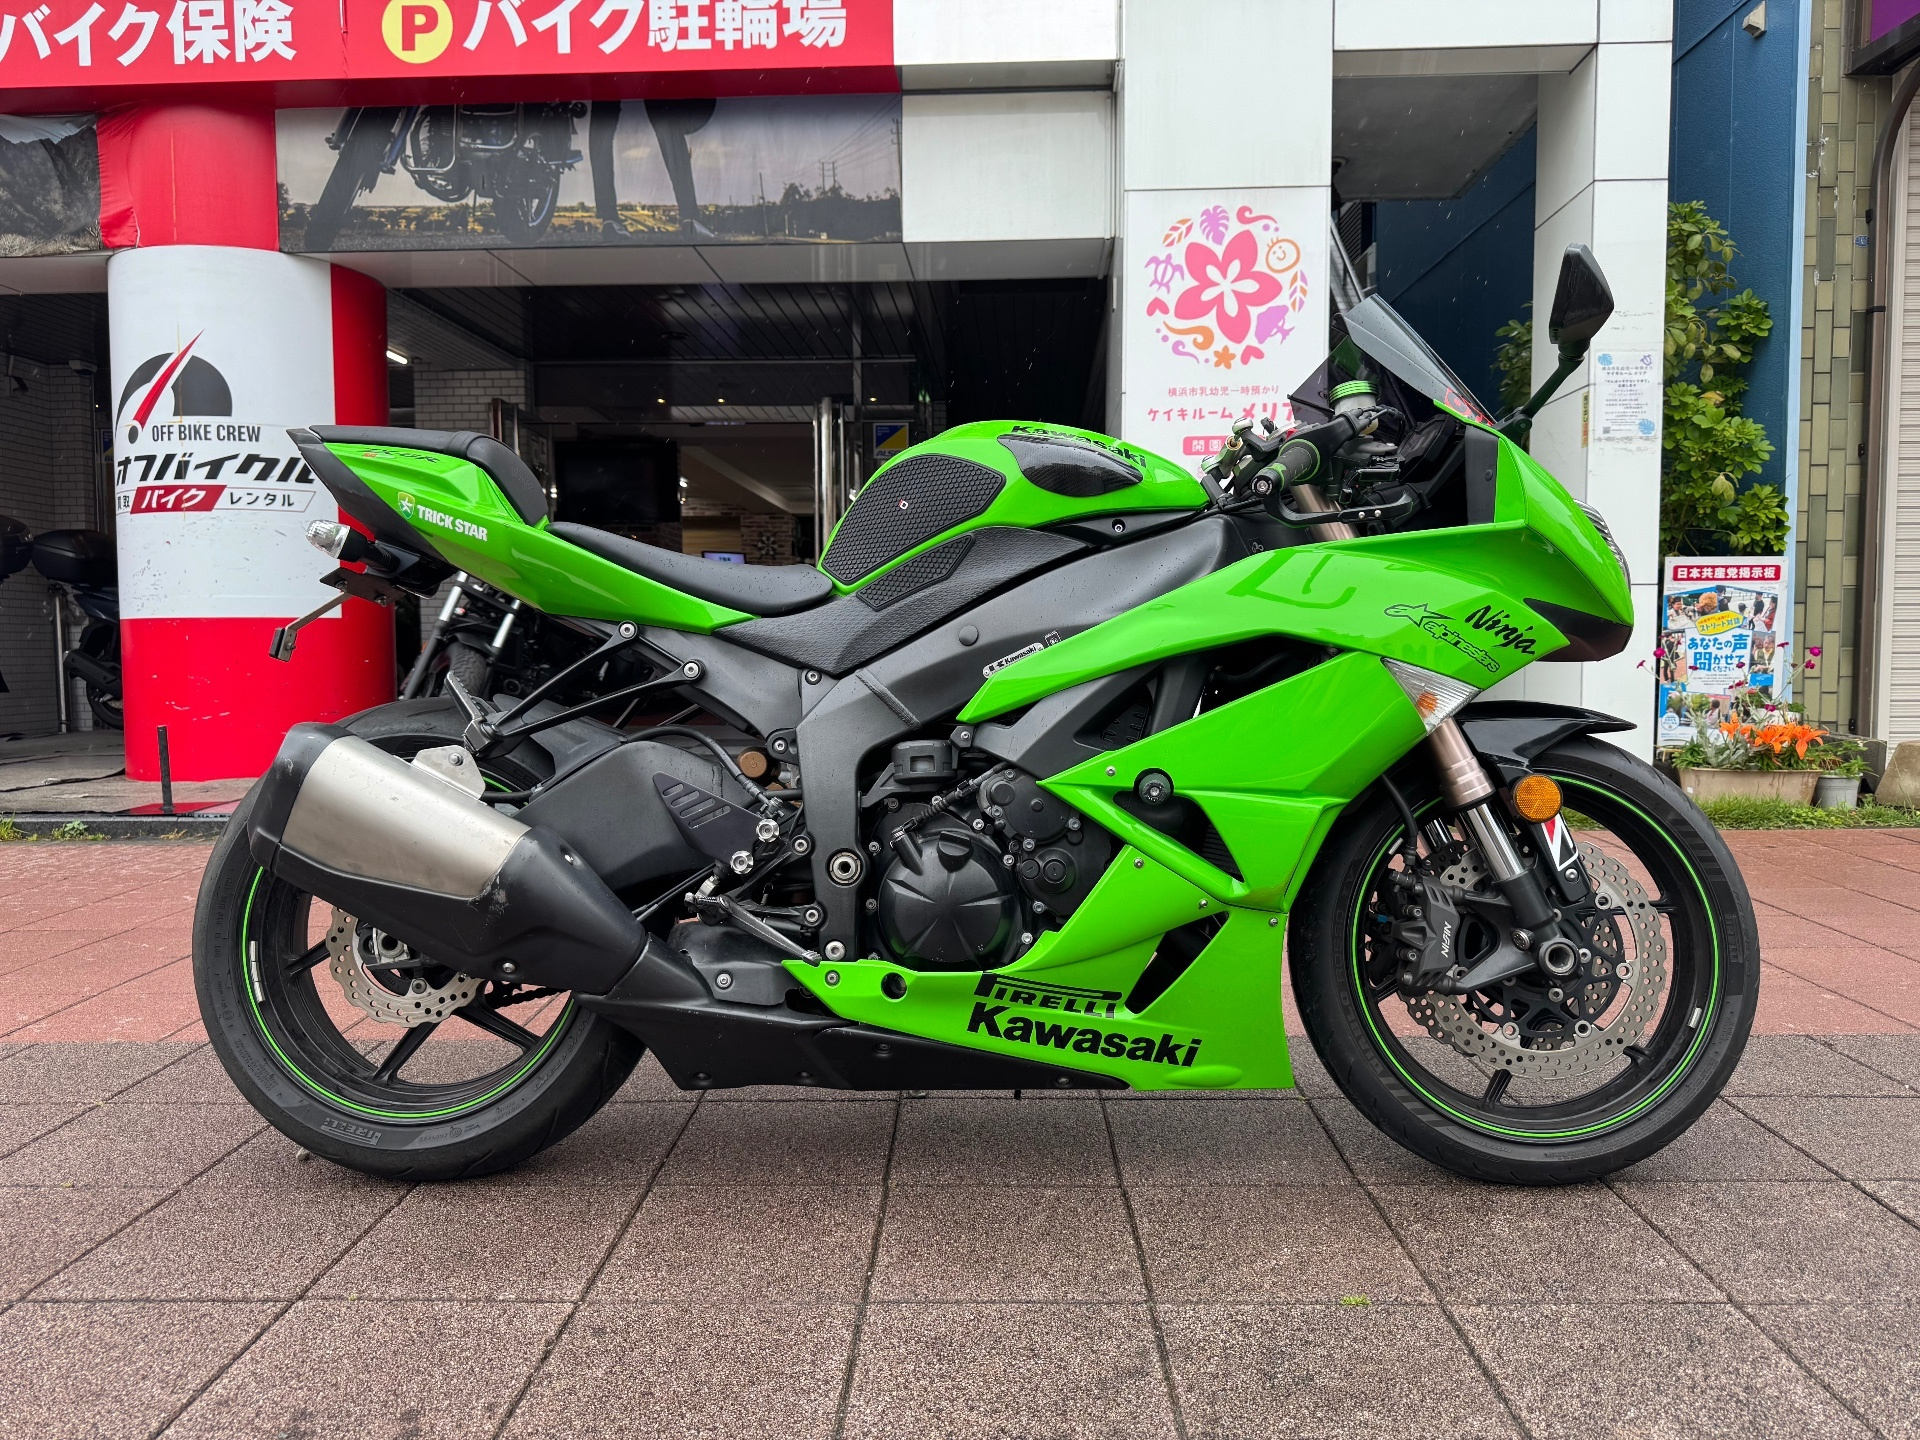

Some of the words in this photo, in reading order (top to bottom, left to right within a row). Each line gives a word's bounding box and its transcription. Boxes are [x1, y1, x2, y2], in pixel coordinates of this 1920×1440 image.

[0, 0, 297, 66] バイク保険
[401, 5, 439, 52] P
[463, 0, 847, 55] バイク駐輪場
[1168, 385, 1279, 397] 横浜市乳幼児一時預かり
[1148, 406, 1234, 422] ケイキルーム
[151, 424, 174, 442] OFF
[178, 423, 212, 442] BIKE
[216, 424, 261, 443] CREW
[1011, 425, 1147, 468] Kawasaki
[1191, 439, 1222, 453] 開園
[116, 452, 316, 486] オフバイクル
[141, 487, 206, 509] バイク
[229, 491, 295, 508] レンタル
[416, 504, 454, 530] TRICK
[454, 518, 489, 542] STAR
[1676, 566, 1776, 579] 日本共産党掲示板
[1465, 604, 1537, 656] Ninja
[1699, 617, 1741, 632] ストリート対話
[1004, 645, 1037, 665] Kawasaki
[1422, 620, 1501, 673] alpinestars
[1687, 633, 1750, 653] あなたの声
[1693, 651, 1745, 672] 聞かせて
[974, 972, 1122, 1019] PIRELLI
[966, 1000, 1203, 1068] Kawasaki
